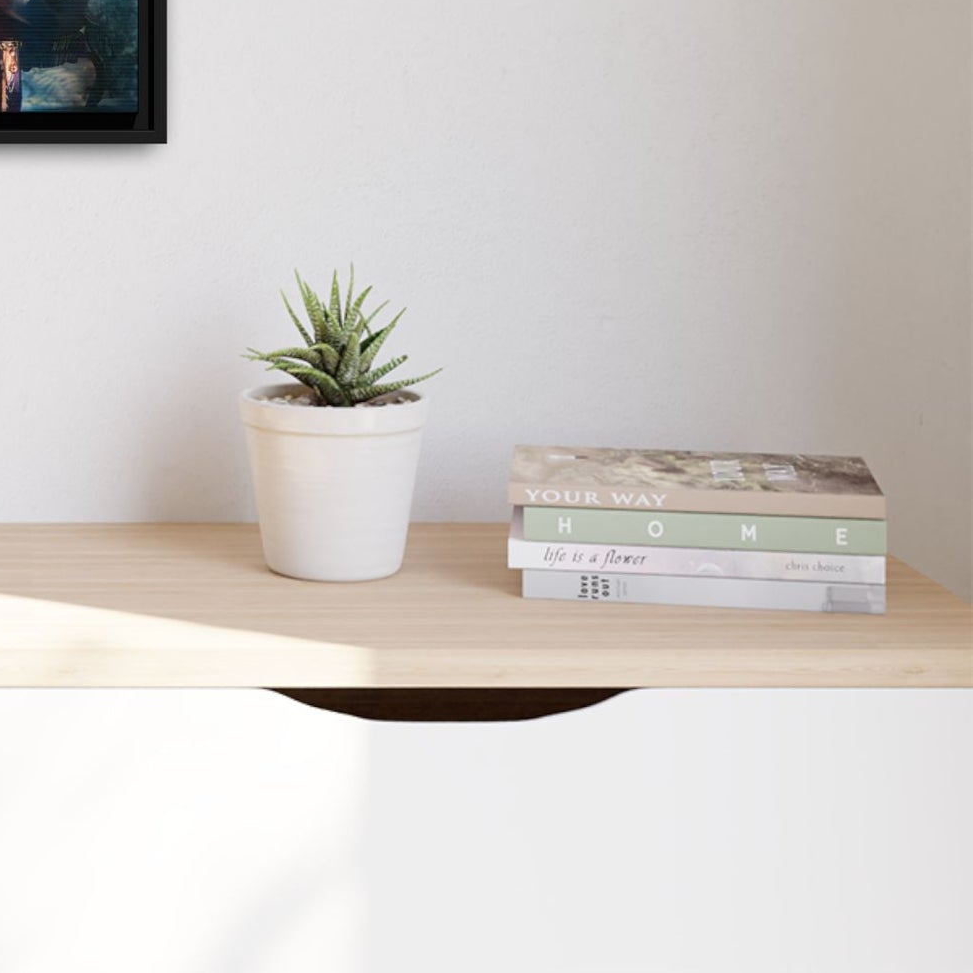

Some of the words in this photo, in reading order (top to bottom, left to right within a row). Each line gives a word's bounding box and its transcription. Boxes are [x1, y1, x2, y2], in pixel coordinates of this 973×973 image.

[525, 489, 600, 504] YOUR
[611, 492, 667, 506] WAY
[544, 547, 566, 567] life
[572, 550, 584, 563] is
[589, 554, 598, 563] a
[600, 549, 648, 569] flower
[785, 560, 809, 571] chris
[812, 561, 845, 573] choice
[578, 575, 588, 598] love
[591, 575, 599, 600] runs
[601, 578, 609, 597] out
